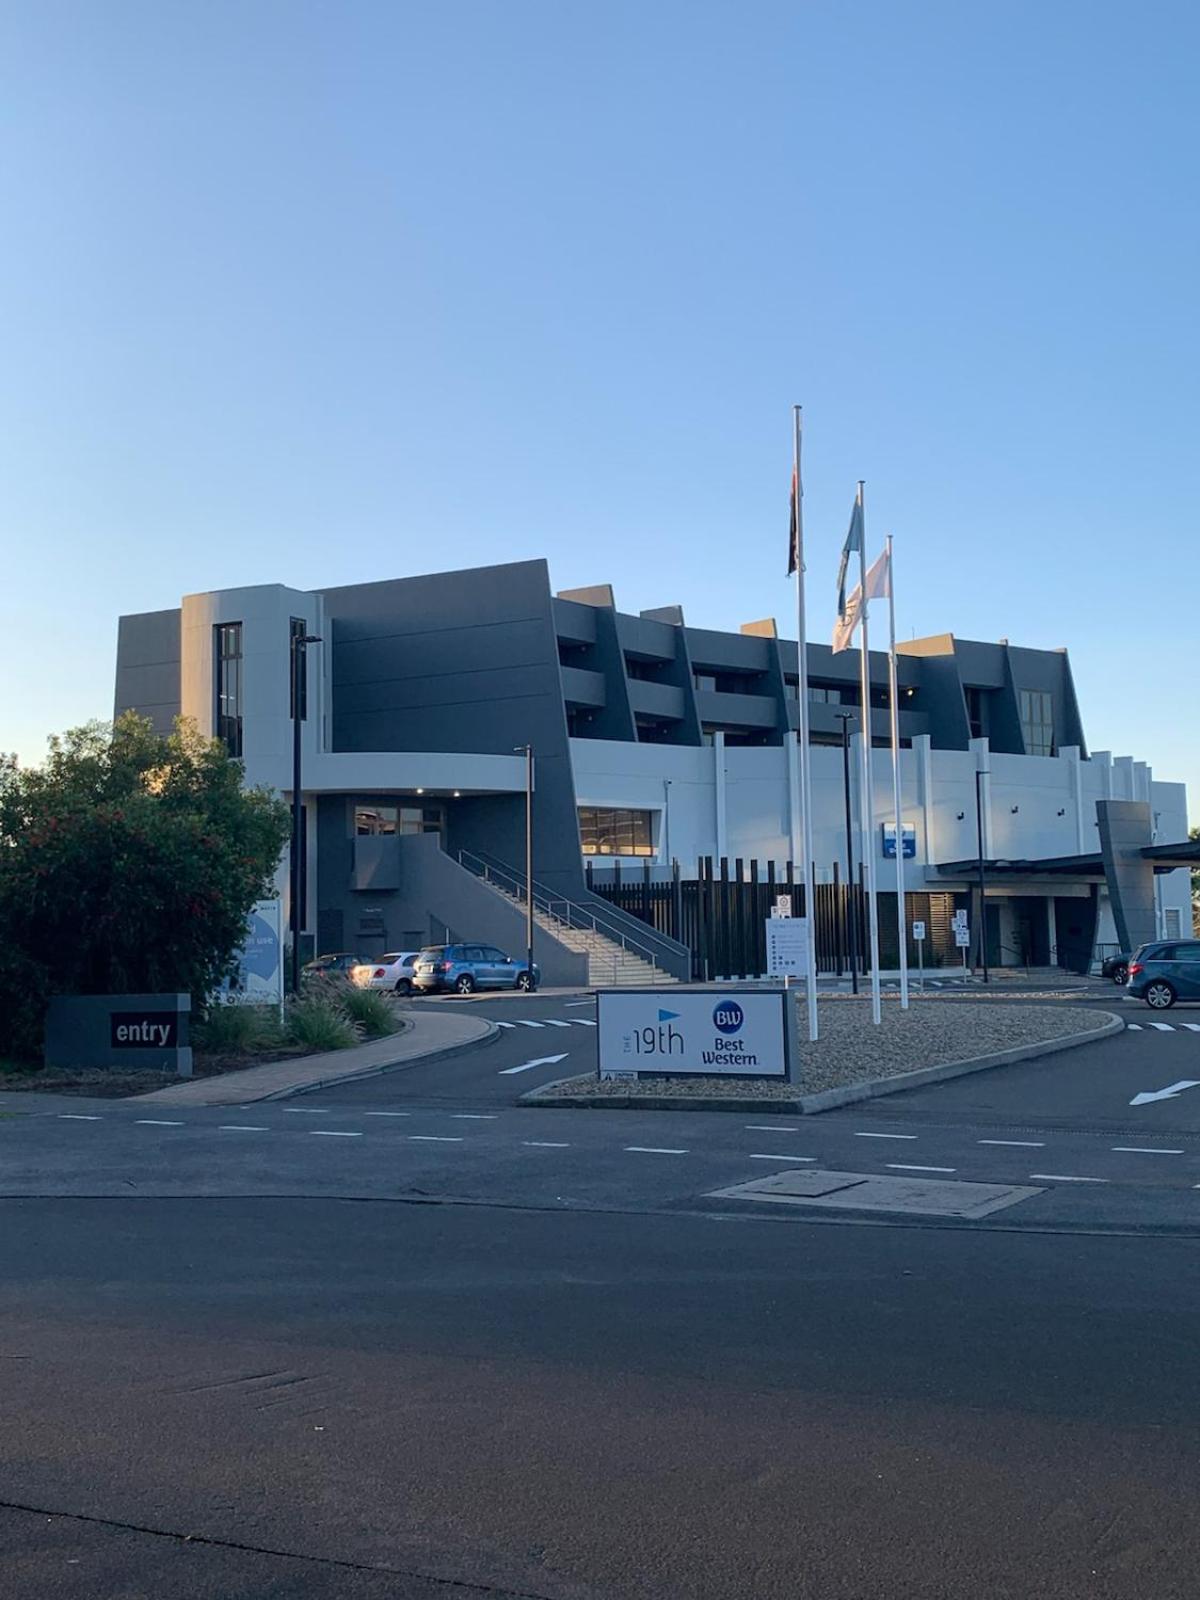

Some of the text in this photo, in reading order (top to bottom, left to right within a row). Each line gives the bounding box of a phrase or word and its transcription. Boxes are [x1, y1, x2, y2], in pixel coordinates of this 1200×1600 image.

[716, 1010, 743, 1026] BW
[116, 1020, 171, 1046] entry
[633, 1023, 684, 1055] 19th
[715, 1038, 744, 1052] Best
[702, 1051, 757, 1066] Western
